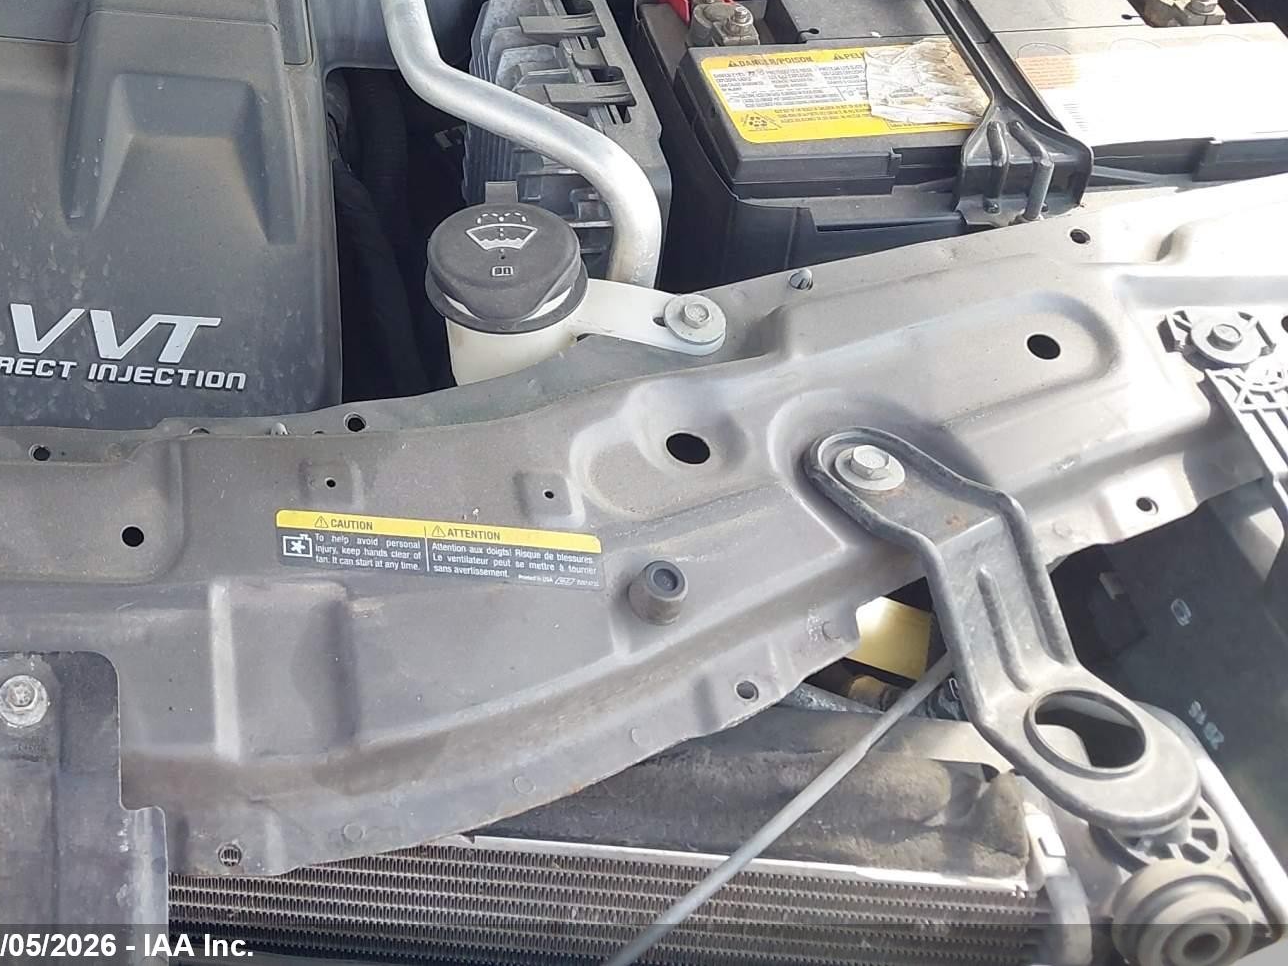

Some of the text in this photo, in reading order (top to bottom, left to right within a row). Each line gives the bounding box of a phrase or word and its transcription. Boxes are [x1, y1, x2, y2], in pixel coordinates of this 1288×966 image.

[10, 303, 222, 364] VVT
[88, 362, 247, 391] INJECTION
[331, 518, 373, 531] CAUTION
[315, 533, 420, 549] To help avoid personal
[447, 527, 500, 541] ATTENTION
[341, 546, 360, 557] keep
[364, 547, 387, 557] hands
[391, 550, 410, 559] clear
[413, 551, 421, 560] of
[432, 541, 466, 552] Attention
[469, 545, 483, 554] aux
[486, 546, 512, 557] doigts!
[515, 549, 541, 560] Risque
[544, 552, 554, 561] de
[315, 554, 330, 564] fan.
[339, 557, 353, 566] can
[355, 558, 373, 567] start
[375, 559, 383, 568] at
[384, 561, 398, 571] any
[401, 561, 420, 571] time.
[433, 553, 443, 562] Le
[447, 555, 488, 566] ventilateur
[493, 558, 511, 568] peut
[515, 560, 524, 569] se
[529, 561, 554, 571] mettre
[568, 564, 597, 575] tourner
[433, 563, 510, 578] sans avertissement.
